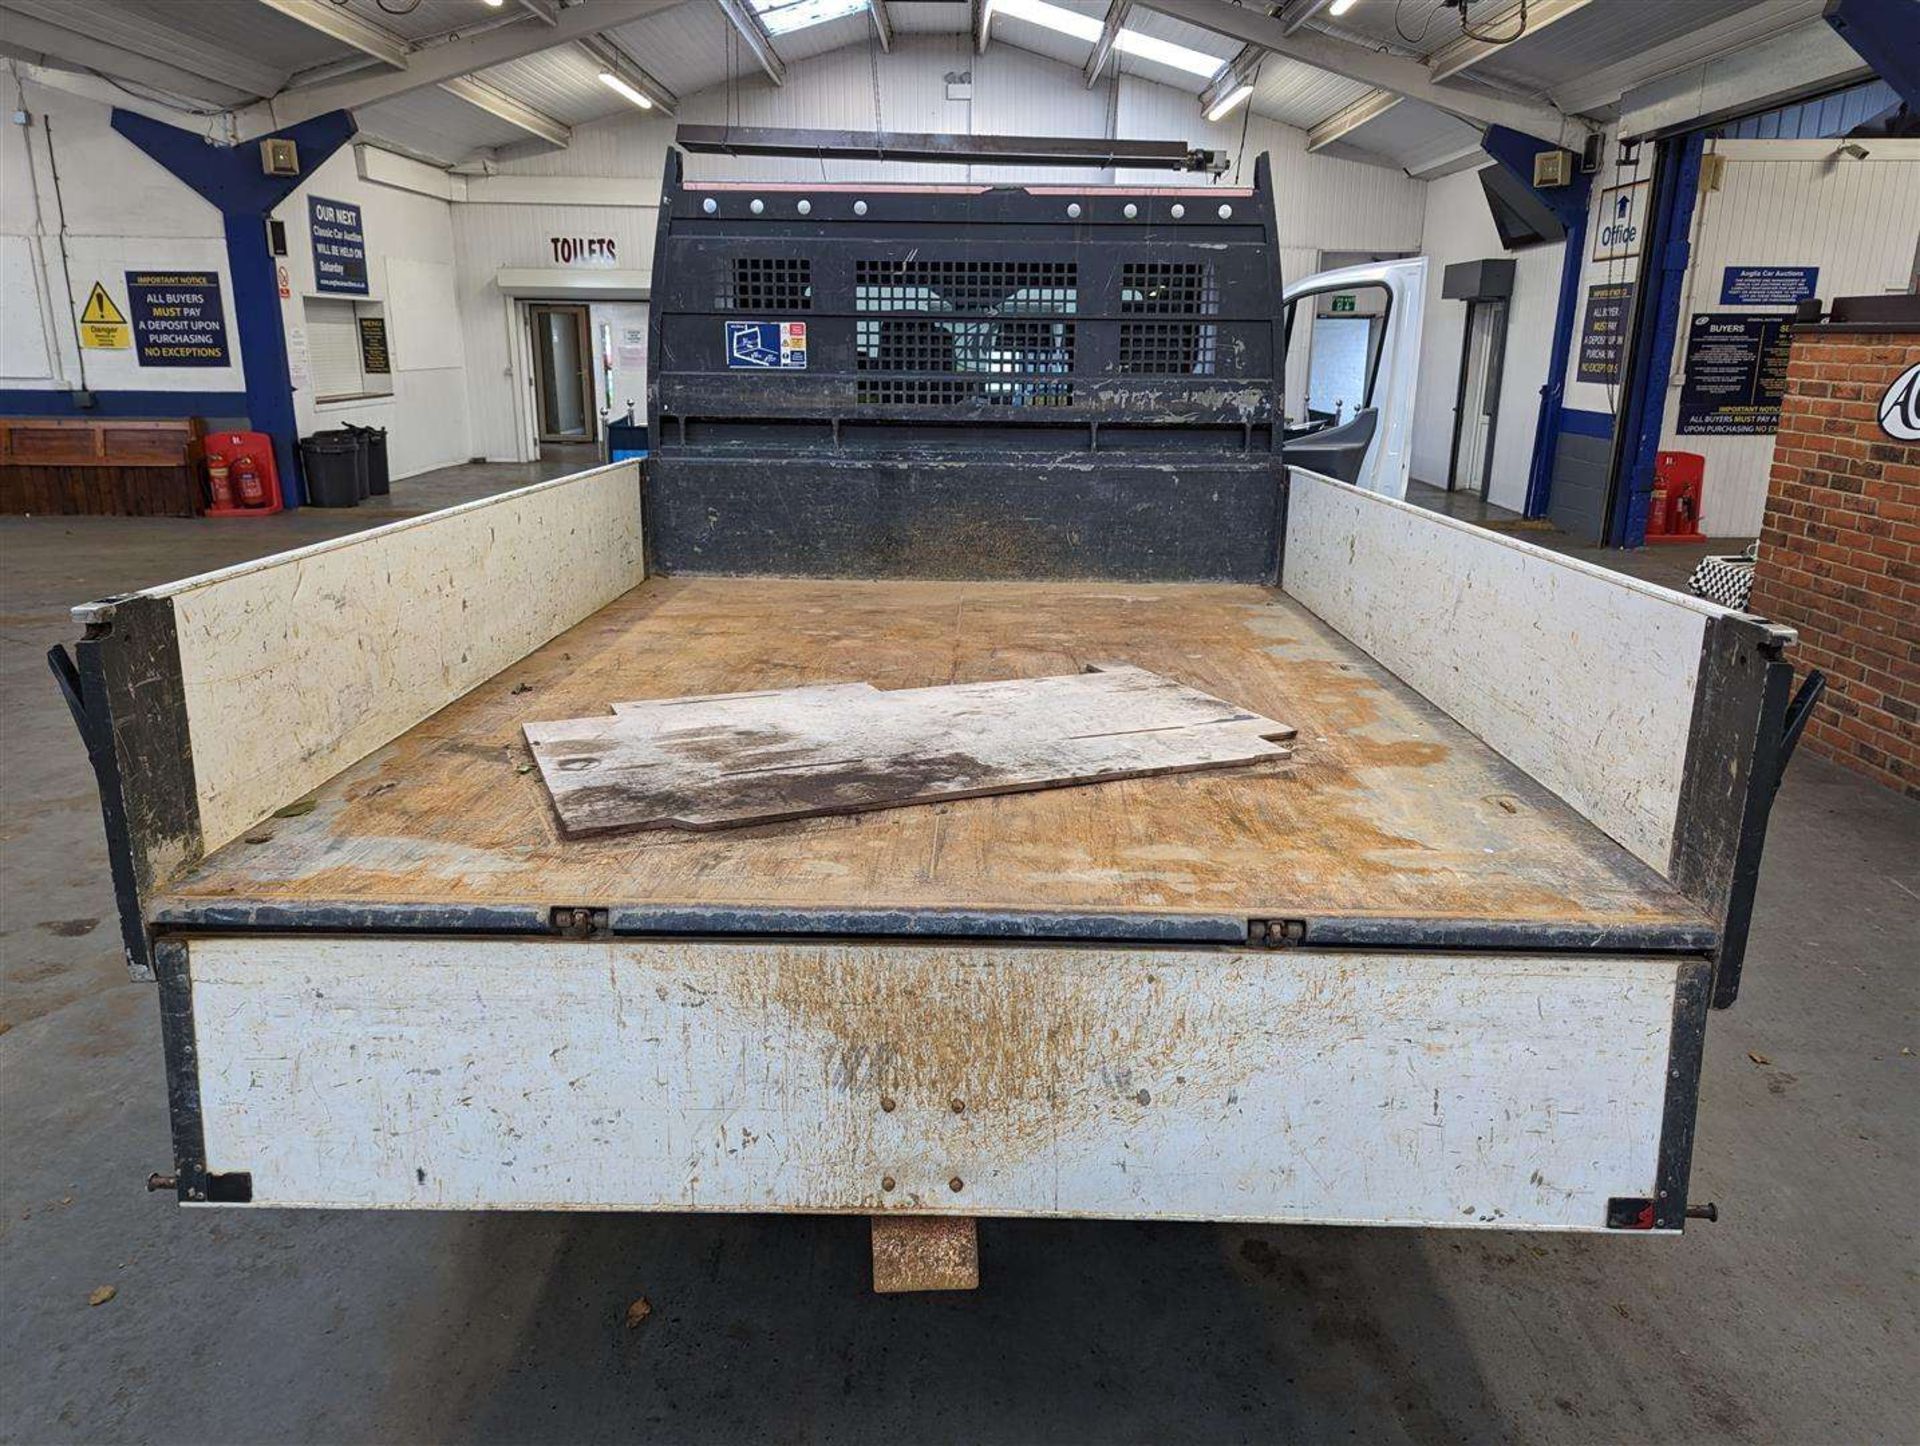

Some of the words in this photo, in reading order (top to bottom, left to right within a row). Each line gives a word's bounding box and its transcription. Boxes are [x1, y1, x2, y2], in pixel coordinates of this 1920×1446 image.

[316, 204, 335, 222] OUR
[335, 208, 357, 226] NEXT
[313, 225, 333, 238] Classic
[333, 229, 343, 239] Car
[1602, 224, 1636, 246] Office
[316, 243, 331, 255] WILL
[331, 245, 339, 256] BE
[340, 247, 353, 258] HELD
[354, 249, 363, 259] ON
[550, 237, 617, 264] TOILETS
[320, 260, 344, 276] Saturday
[1740, 270, 1761, 278] Anglia
[137, 276, 179, 284] IMPORTANT
[180, 276, 207, 284] NOTICE
[146, 293, 165, 304] ALL
[165, 293, 205, 304] BUYERS
[152, 307, 181, 317] MUST
[183, 307, 202, 317] PAY
[139, 320, 146, 331] A
[147, 320, 189, 331] DEPOSIT
[190, 320, 220, 331] UPON
[1709, 324, 1746, 333] BUYERS
[149, 333, 214, 344] PURCHASING
[145, 347, 160, 357] NO
[162, 347, 222, 357] EXCEPTIONS
[1683, 425, 1705, 433] UPON
[1706, 425, 1755, 433] PURCHASING
[1755, 425, 1767, 433] NO
